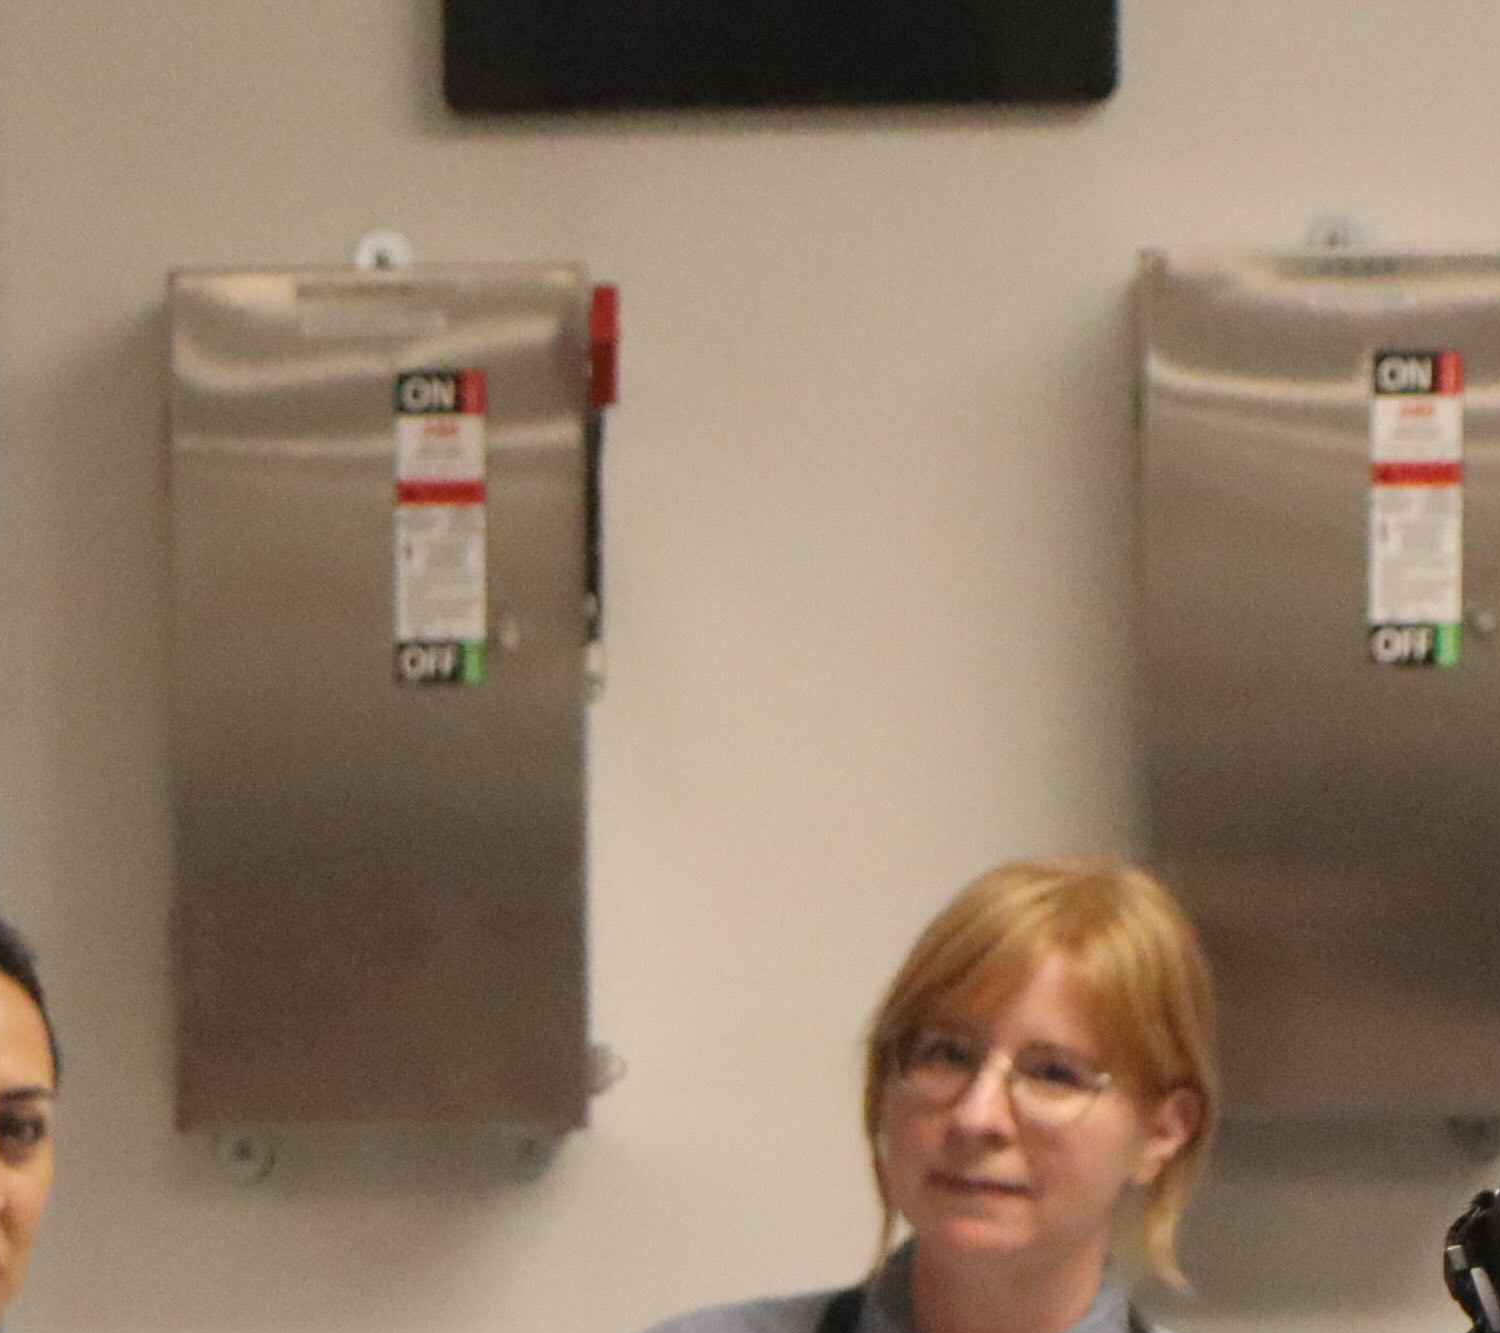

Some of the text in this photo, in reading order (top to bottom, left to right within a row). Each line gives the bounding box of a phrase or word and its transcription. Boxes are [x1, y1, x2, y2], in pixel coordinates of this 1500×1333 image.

[1377, 357, 1433, 391] ON
[402, 377, 456, 411] ON
[402, 645, 458, 678] OFF
[1371, 627, 1434, 662] OFF
